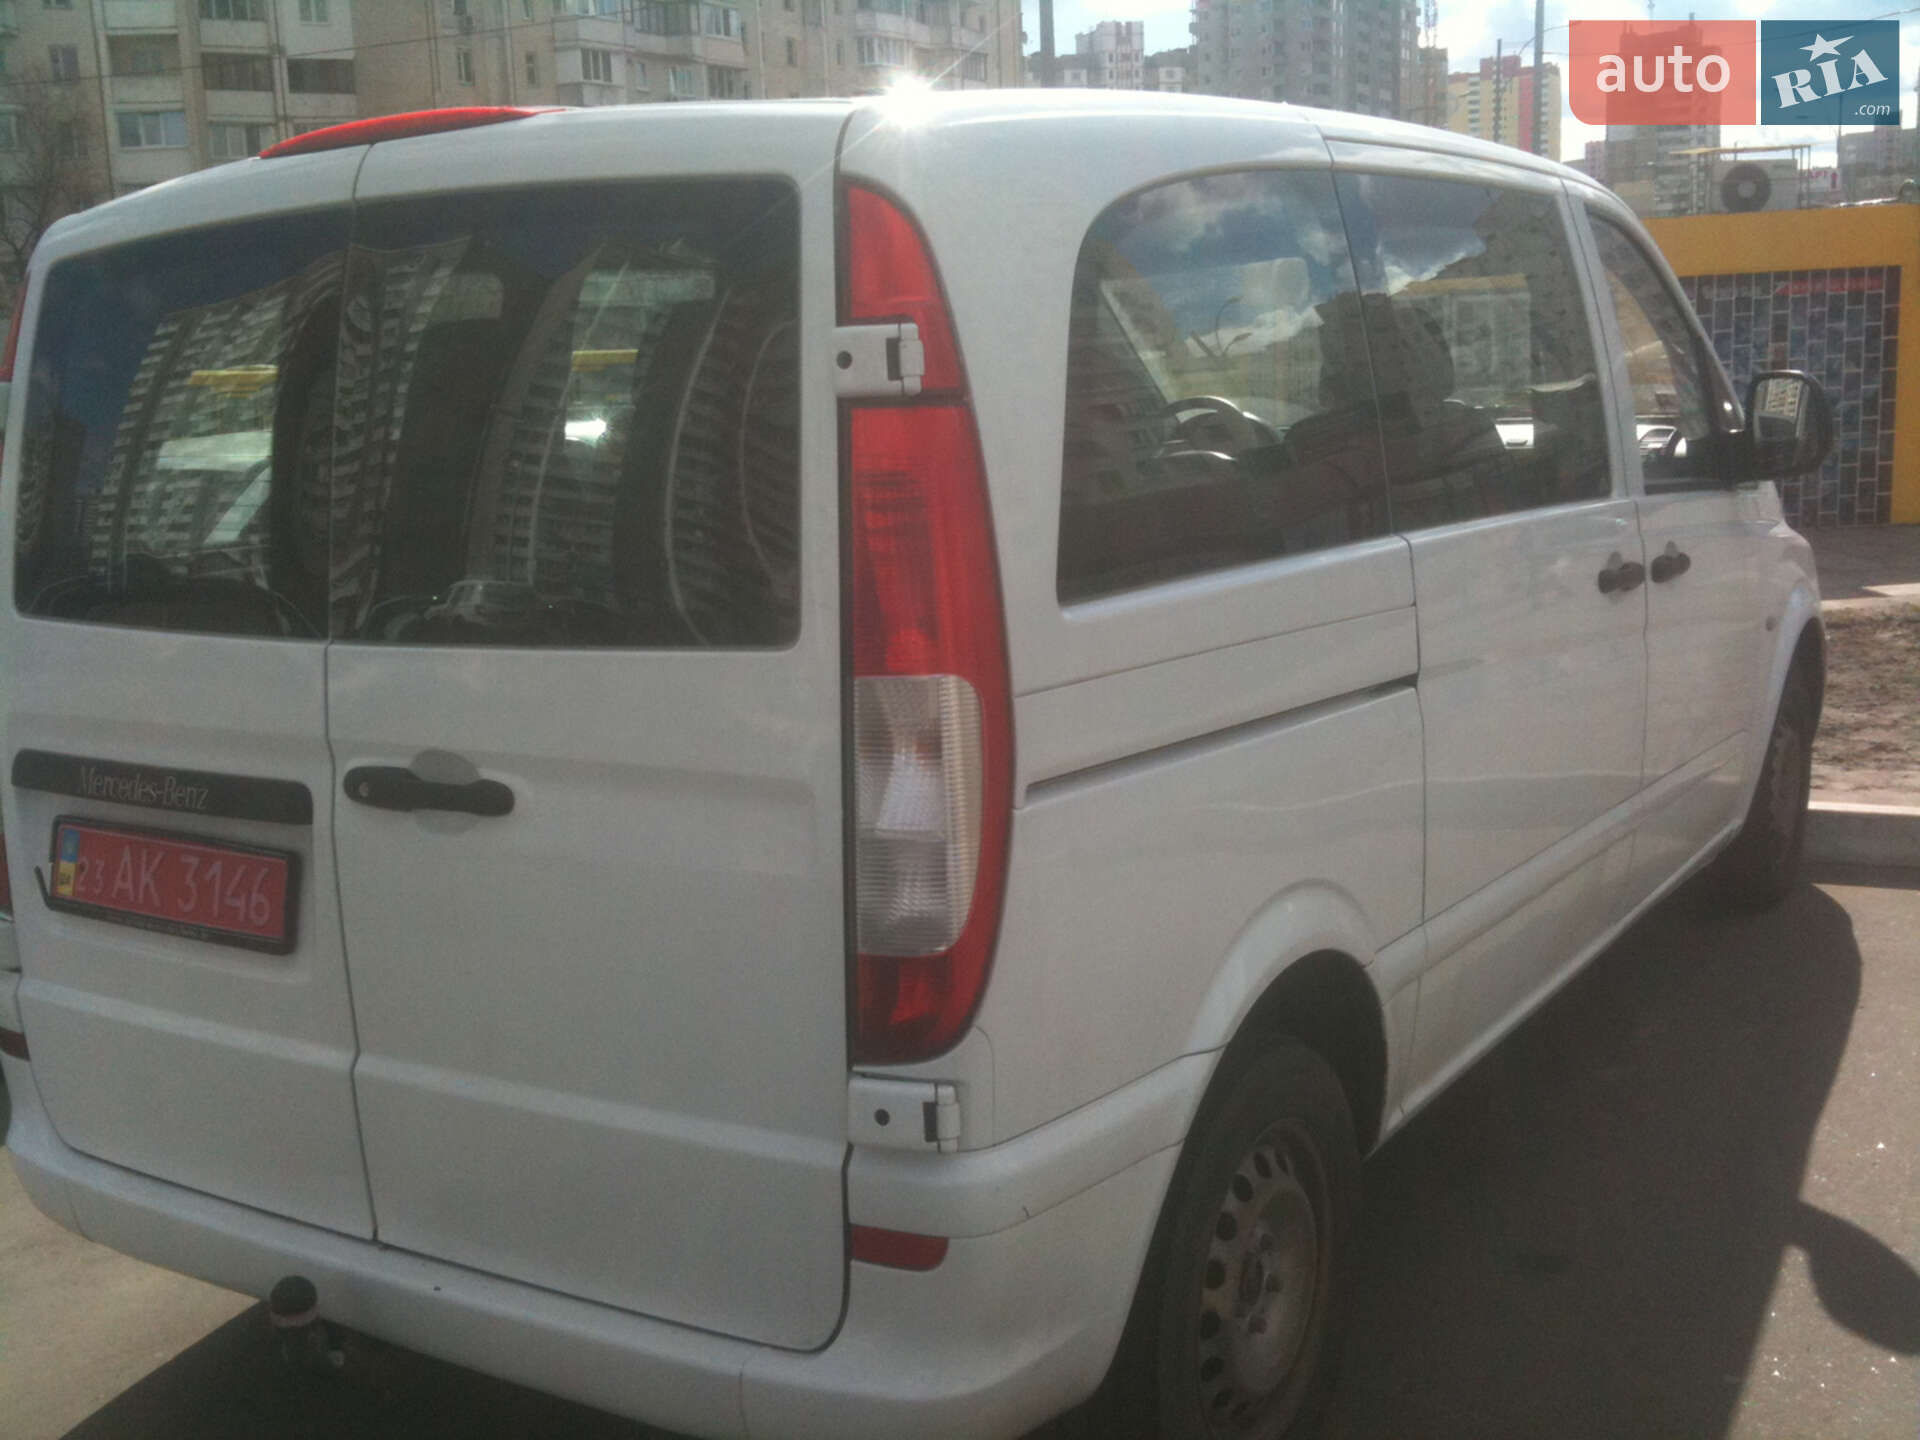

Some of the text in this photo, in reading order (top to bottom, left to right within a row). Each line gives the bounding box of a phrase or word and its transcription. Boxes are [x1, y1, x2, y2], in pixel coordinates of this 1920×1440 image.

[80, 765, 209, 810] Mercedes-Benz
[111, 844, 165, 907] AK
[177, 854, 272, 927] 3146
